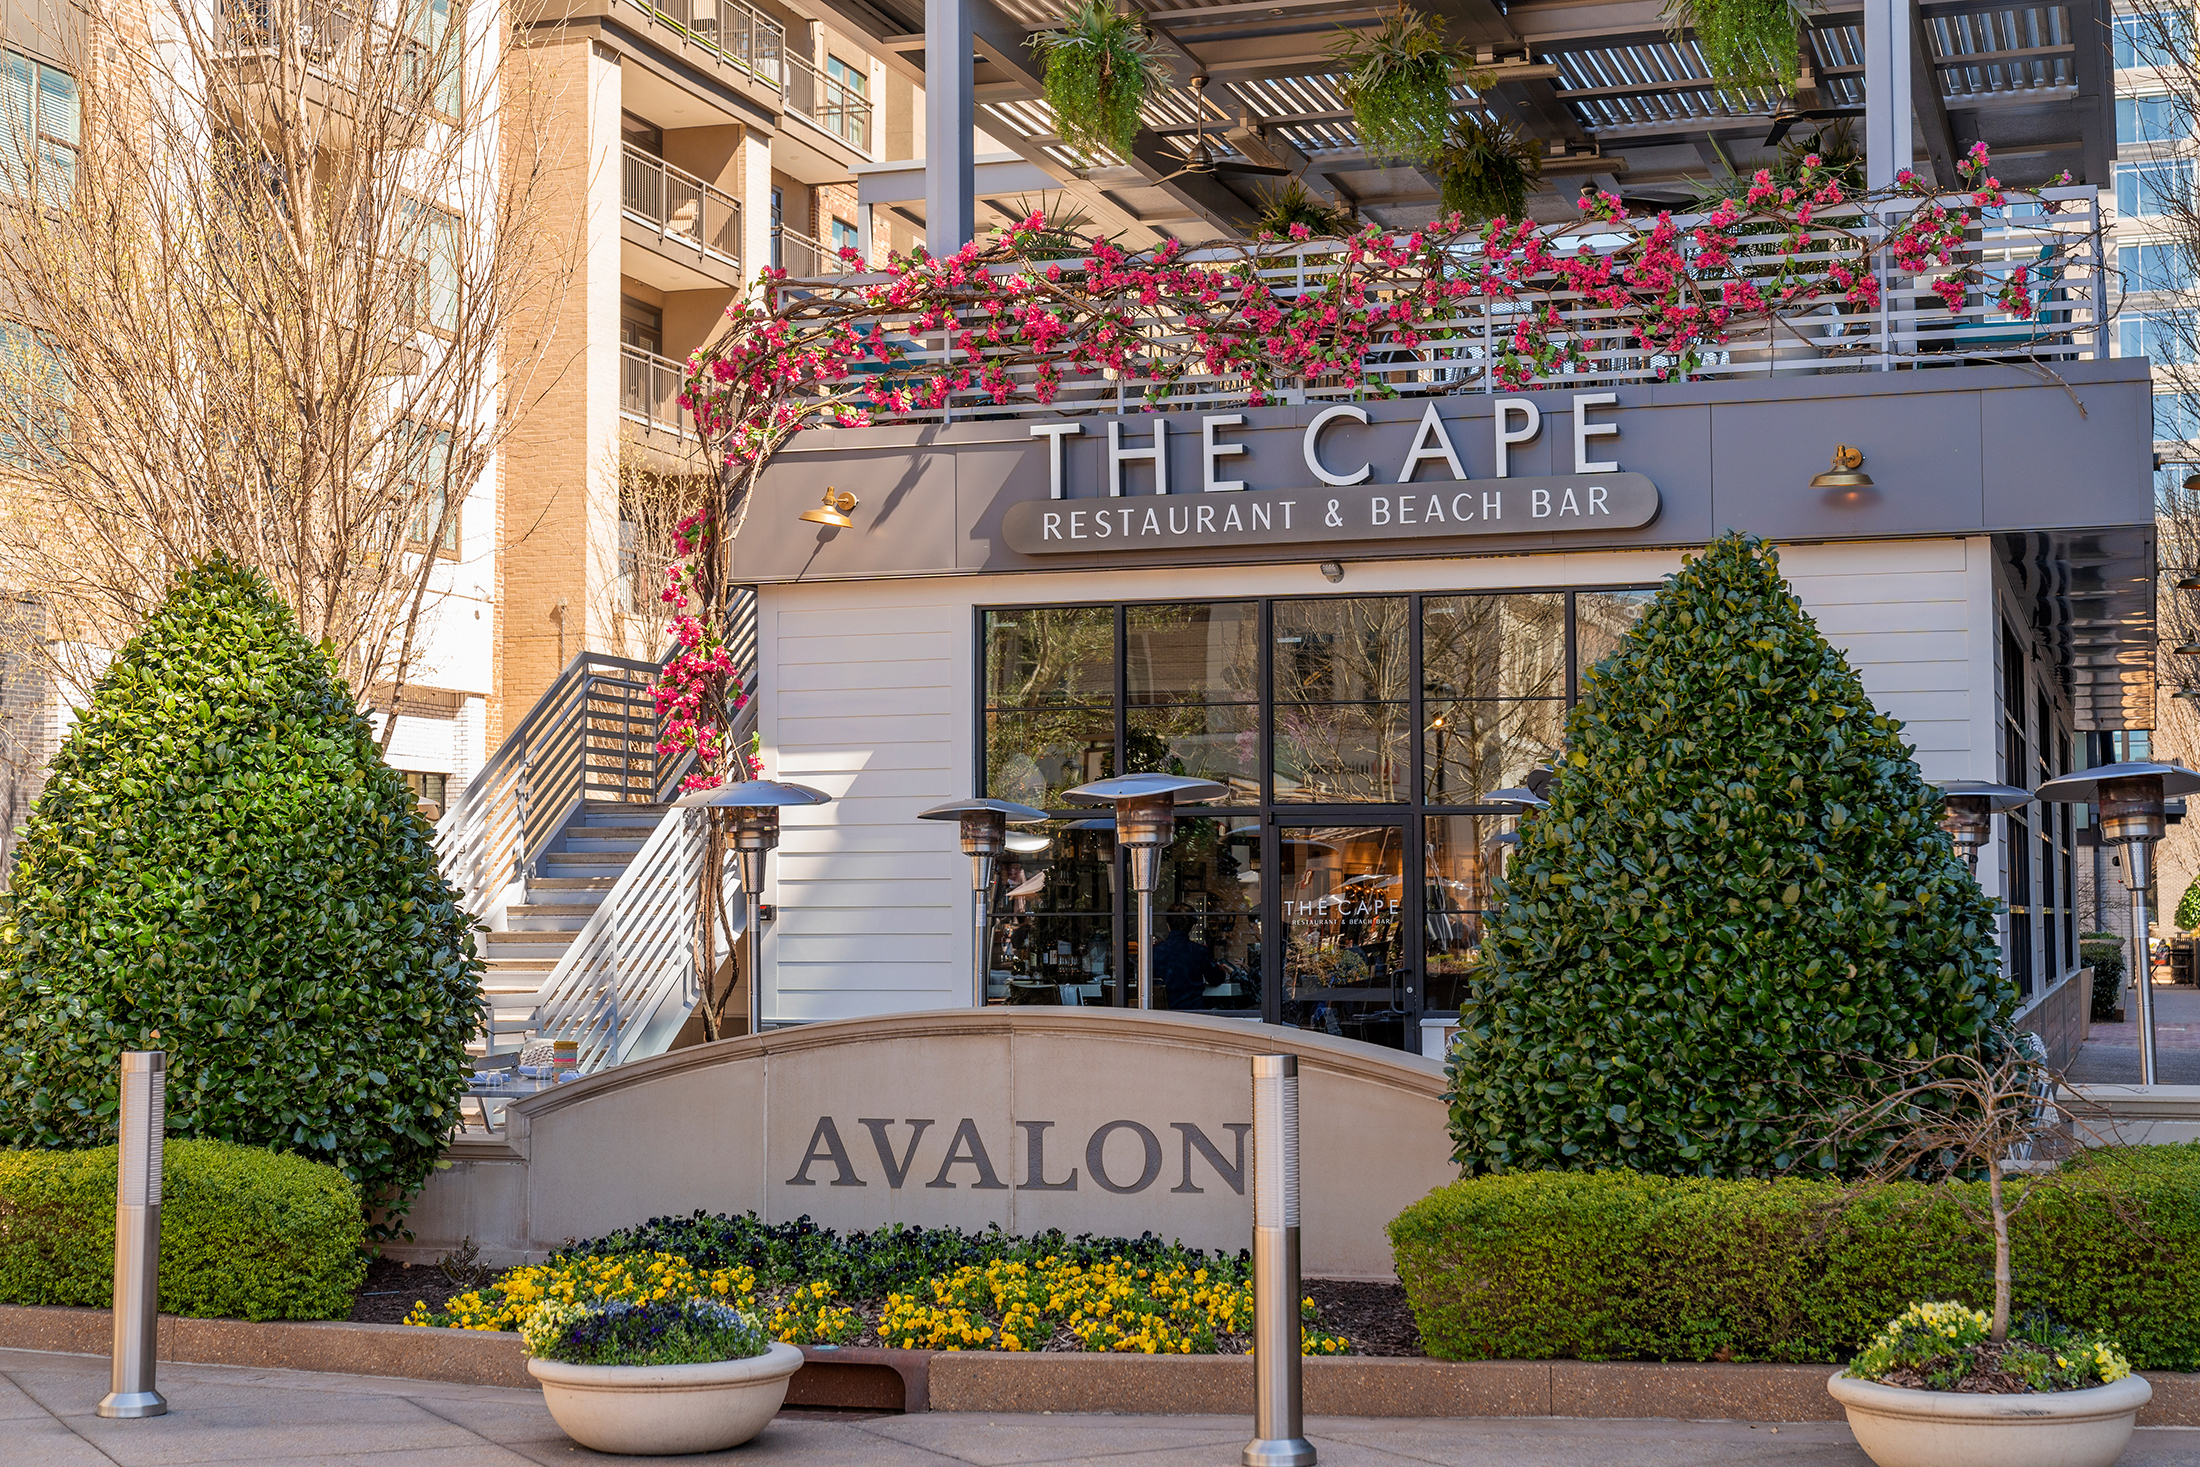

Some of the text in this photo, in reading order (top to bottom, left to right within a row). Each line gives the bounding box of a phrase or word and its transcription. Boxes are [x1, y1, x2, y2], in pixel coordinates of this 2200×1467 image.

[1030, 392, 1621, 499] THE CAPE
[1043, 486, 1610, 541] RESTAURANT & BEACH BAR
[1283, 899, 1399, 916] THE CAPE
[1292, 918, 1337, 926] RESTAURANT
[785, 1115, 1252, 1196] AVALON
